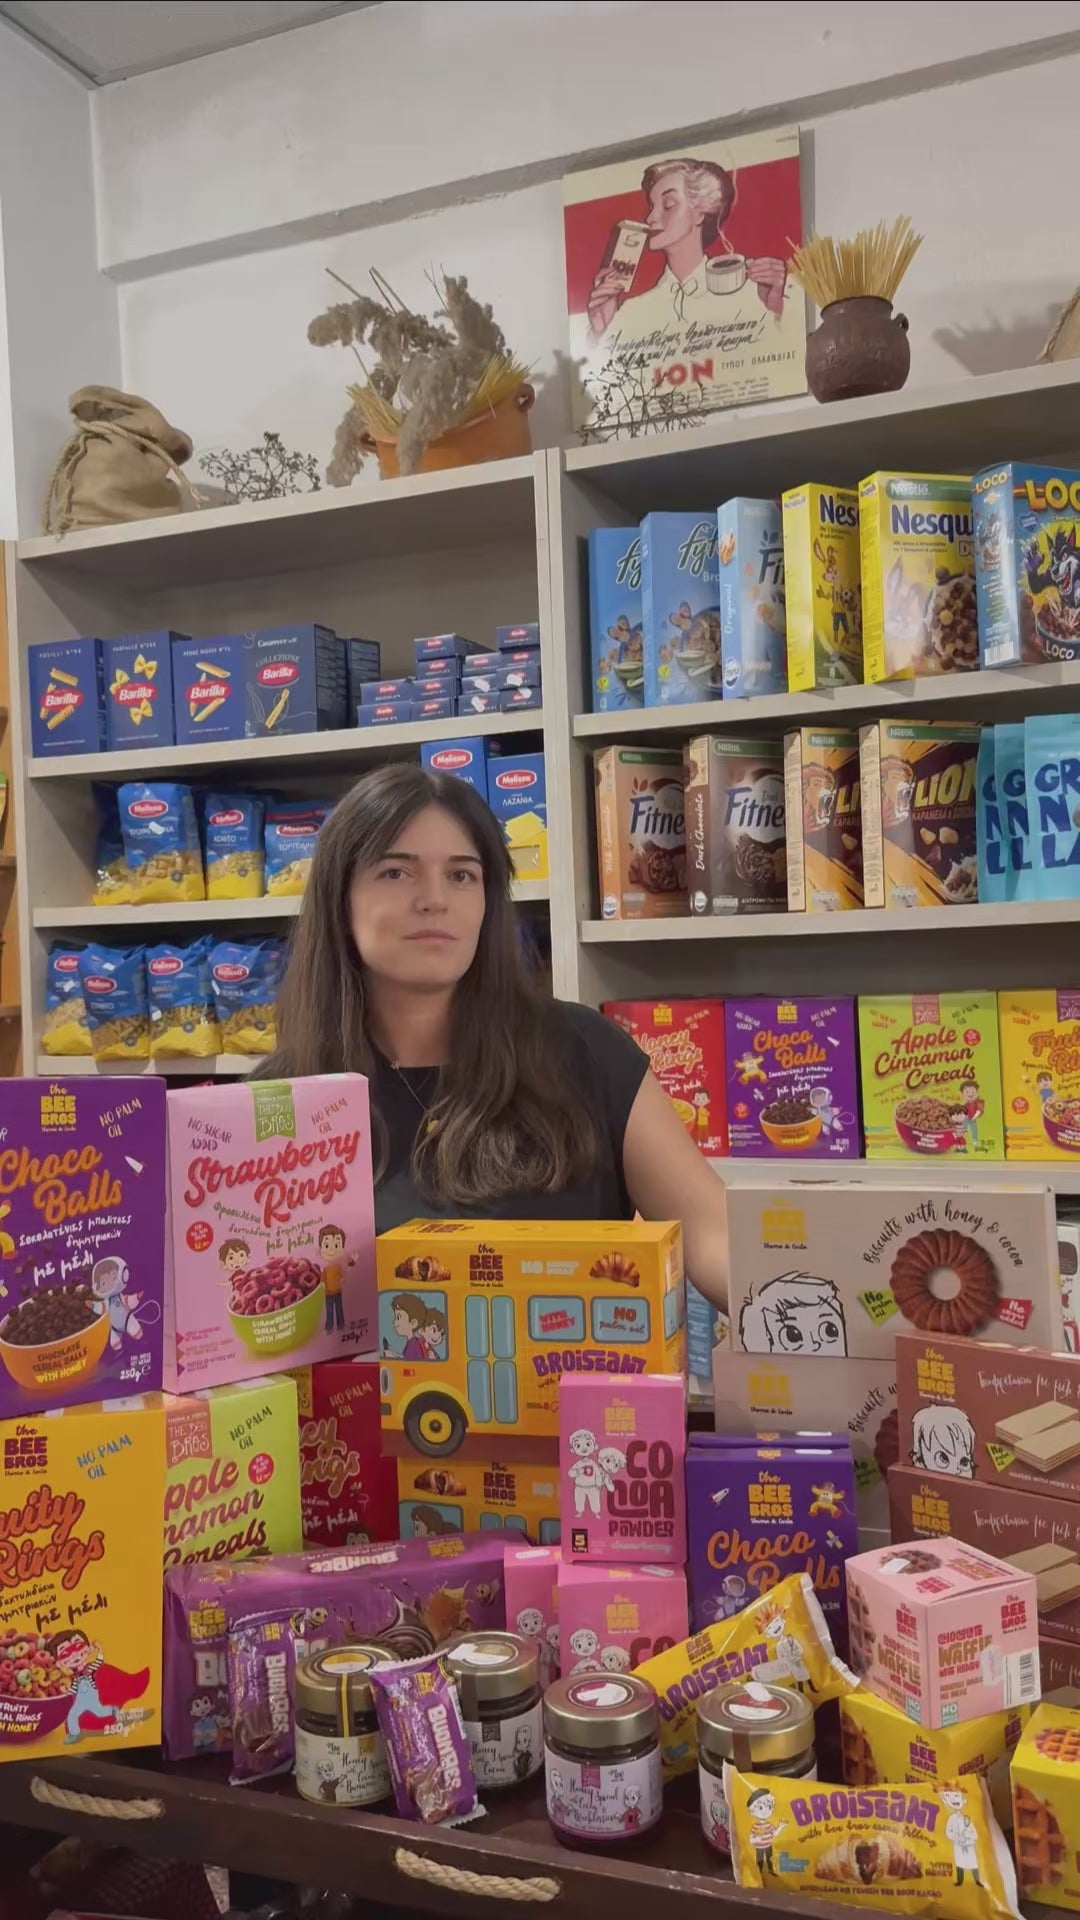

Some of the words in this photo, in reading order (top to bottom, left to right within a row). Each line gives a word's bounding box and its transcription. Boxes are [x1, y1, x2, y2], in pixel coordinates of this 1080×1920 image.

[653, 358, 714, 388] ION
[975, 471, 1009, 494] LOCO
[1044, 639, 1074, 659] LOCO
[262, 666, 295, 681] Barilla
[45, 692, 80, 707] Barilla
[119, 686, 154, 701] Barilla
[190, 685, 227, 700] Barilla
[753, 1029, 814, 1053] Choco
[892, 1026, 958, 1054] Apple
[775, 1047, 827, 1070] Balls
[874, 1047, 974, 1079] Cinnamon
[905, 1064, 976, 1090] Cereals
[49, 1083, 68, 1095] the
[41, 1095, 76, 1114] BEE
[99, 1111, 115, 1128] NO
[115, 1097, 142, 1120] PALM
[311, 1110, 325, 1126] NO
[325, 1097, 348, 1117] PALM
[41, 1113, 77, 1126] BROS
[259, 1113, 295, 1137] BROS
[187, 1116, 203, 1132] NO
[204, 1122, 233, 1144] SUGAR
[189, 1138, 219, 1151] ADDED
[0, 1144, 103, 1194] Choco
[184, 1129, 361, 1208] Strawberry
[34, 1168, 123, 1226] Balls
[254, 1161, 348, 1229] Rings
[863, 1213, 905, 1265] Biscuits
[904, 1199, 940, 1226] with
[945, 1198, 983, 1234] honey
[986, 1220, 999, 1234] &
[999, 1235, 1024, 1269] cocoa
[478, 1243, 495, 1254] the
[33, 1262, 56, 1286] με
[60, 1250, 94, 1280] μέλι
[469, 1254, 504, 1270] BEE
[469, 1270, 504, 1282] BROS
[864, 1291, 884, 1304] No
[1008, 1300, 1025, 1314] No
[613, 1306, 637, 1322] NO
[254, 1323, 278, 1337] CEREAL
[599, 1320, 626, 1334] palm
[924, 1347, 945, 1361] the
[916, 1358, 955, 1382] BEE
[329, 1393, 345, 1407] NO
[345, 1380, 373, 1401] PALM
[917, 1378, 956, 1396] BROS
[848, 1386, 886, 1432] Biscuits
[15, 1423, 39, 1436] the
[229, 1426, 246, 1442] NO
[247, 1405, 273, 1429] PALM
[4, 1436, 48, 1456] BEE
[77, 1451, 96, 1469] NO
[97, 1433, 133, 1459] PALM
[170, 1433, 210, 1463] BROS
[4, 1455, 48, 1469] BROS
[491, 1461, 508, 1473] the
[626, 1439, 675, 1479] CO
[165, 1455, 240, 1521] pple
[483, 1472, 516, 1489] BEE
[484, 1489, 516, 1501] BROS
[748, 1484, 792, 1503] BEE
[920, 1484, 941, 1498] the
[749, 1503, 794, 1518] BROS
[911, 1494, 950, 1518] BEE
[608, 1520, 675, 1538] POWDER
[911, 1515, 951, 1533] BROS
[707, 1528, 816, 1570] Choco
[747, 1554, 842, 1595] Blls
[35, 1607, 62, 1633] με
[68, 1592, 108, 1625] μέλι
[896, 1609, 917, 1628] BEE
[1001, 1600, 1026, 1620] BEE
[1001, 1614, 1027, 1630] BROS
[877, 1643, 921, 1686] WAFFLE
[942, 1703, 959, 1715] NO
[7, 1721, 40, 1733] HONEY
[103, 1724, 131, 1737] 250g
[916, 1735, 930, 1747] the
[909, 1741, 937, 1764] BEE
[910, 1756, 938, 1775] BROS
[798, 1827, 823, 1844] with
[824, 1823, 844, 1834] bee
[846, 1820, 870, 1831] bros
